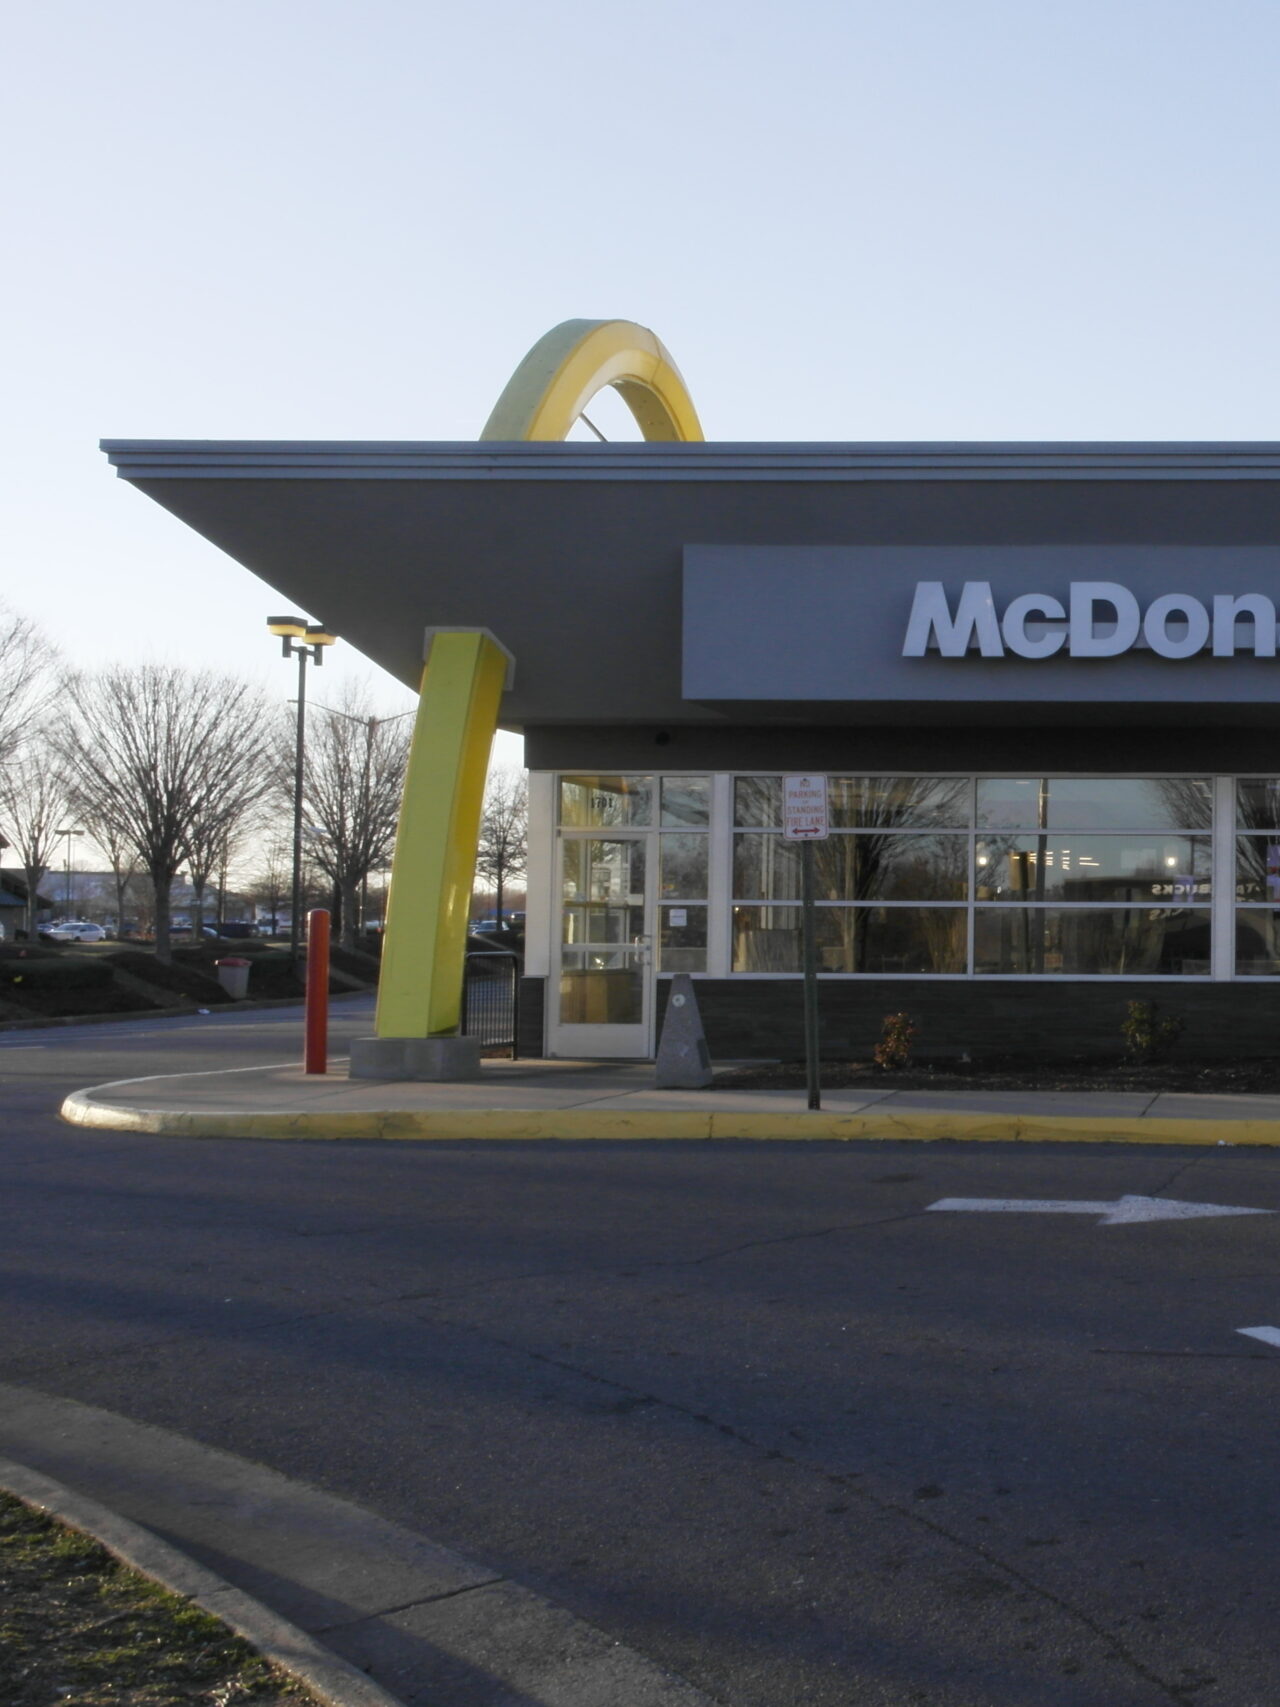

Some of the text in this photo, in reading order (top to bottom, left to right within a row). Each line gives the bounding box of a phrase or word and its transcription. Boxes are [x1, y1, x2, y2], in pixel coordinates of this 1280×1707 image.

[788, 790, 822, 798] PARKING
[787, 806, 825, 814] STANDING
[786, 816, 825, 826] FIRE LANE
